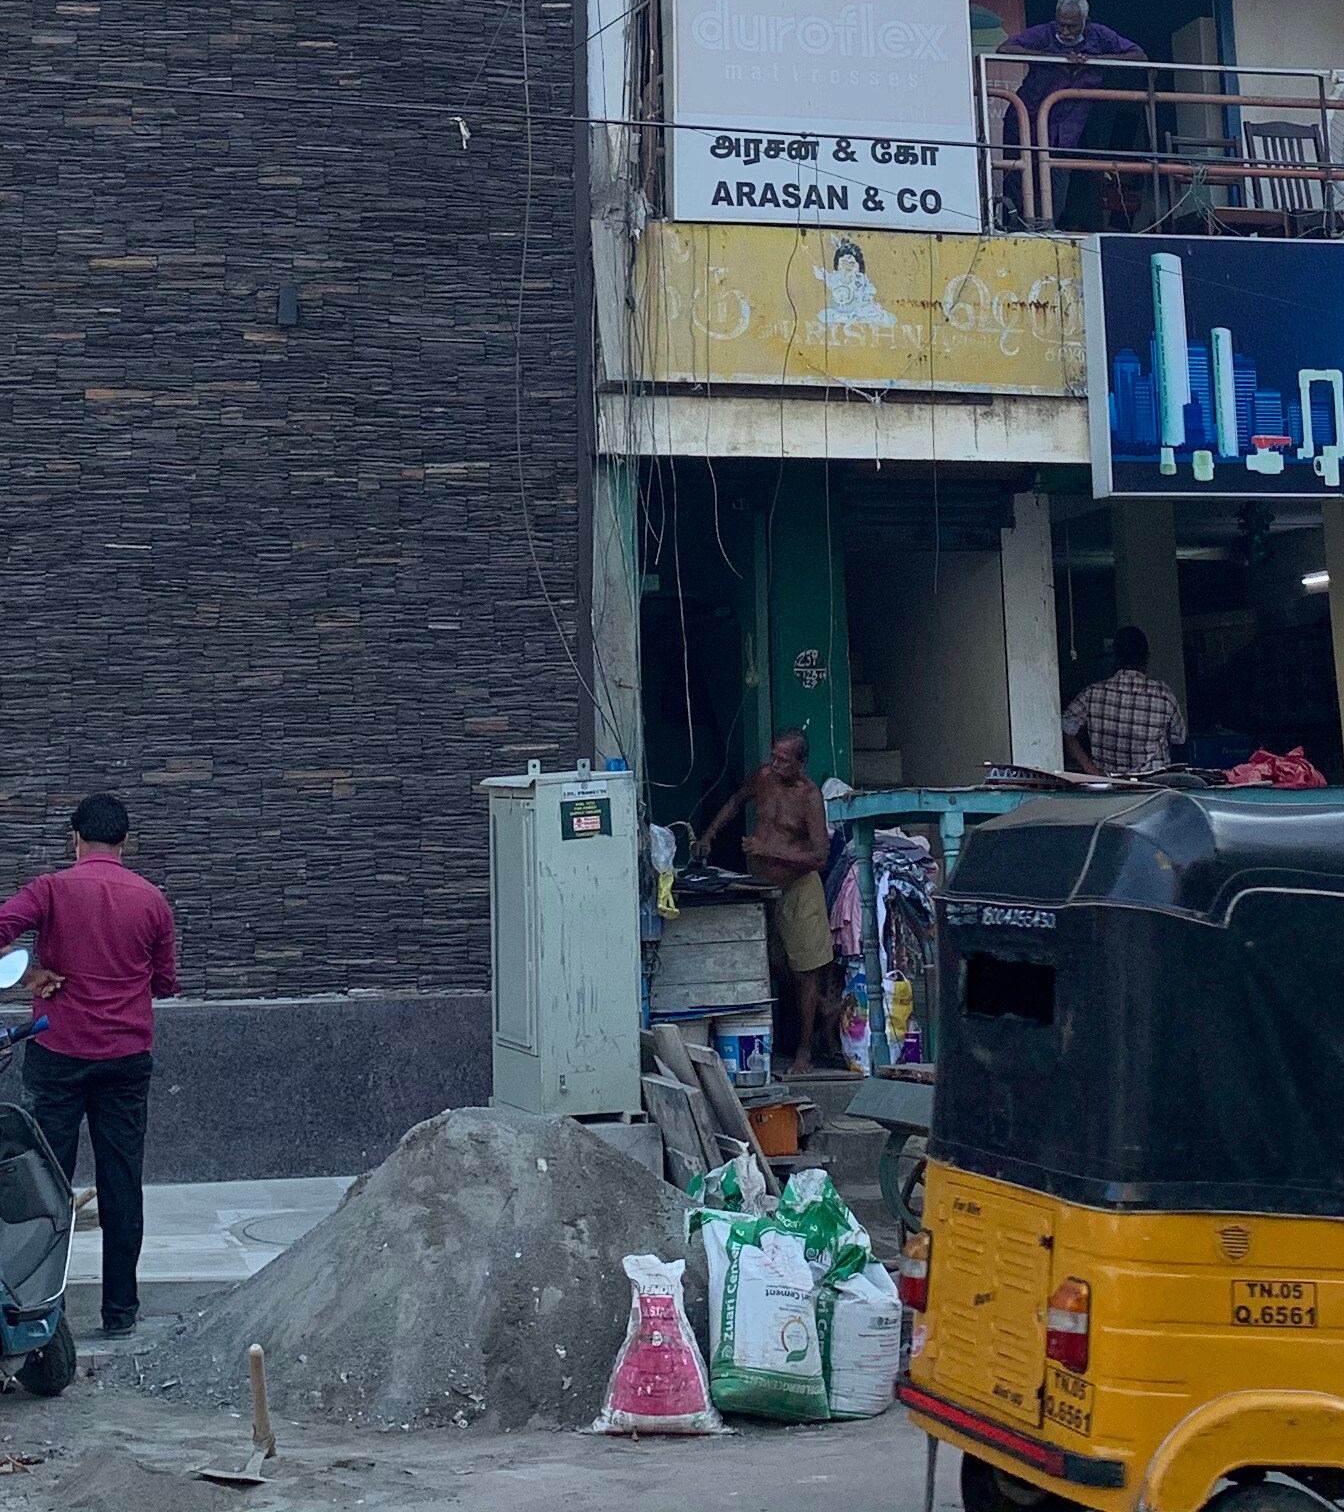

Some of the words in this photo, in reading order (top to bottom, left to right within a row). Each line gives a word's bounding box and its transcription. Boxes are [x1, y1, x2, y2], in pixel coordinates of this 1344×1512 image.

[724, 61, 920, 89] mattresses
[709, 131, 820, 166] அரசன்
[832, 137, 859, 163] &
[870, 138, 940, 166] கோ
[710, 180, 849, 211] ARASAN
[862, 185, 885, 212] &
[896, 187, 943, 215] CO
[723, 1298, 737, 1341] Zuari
